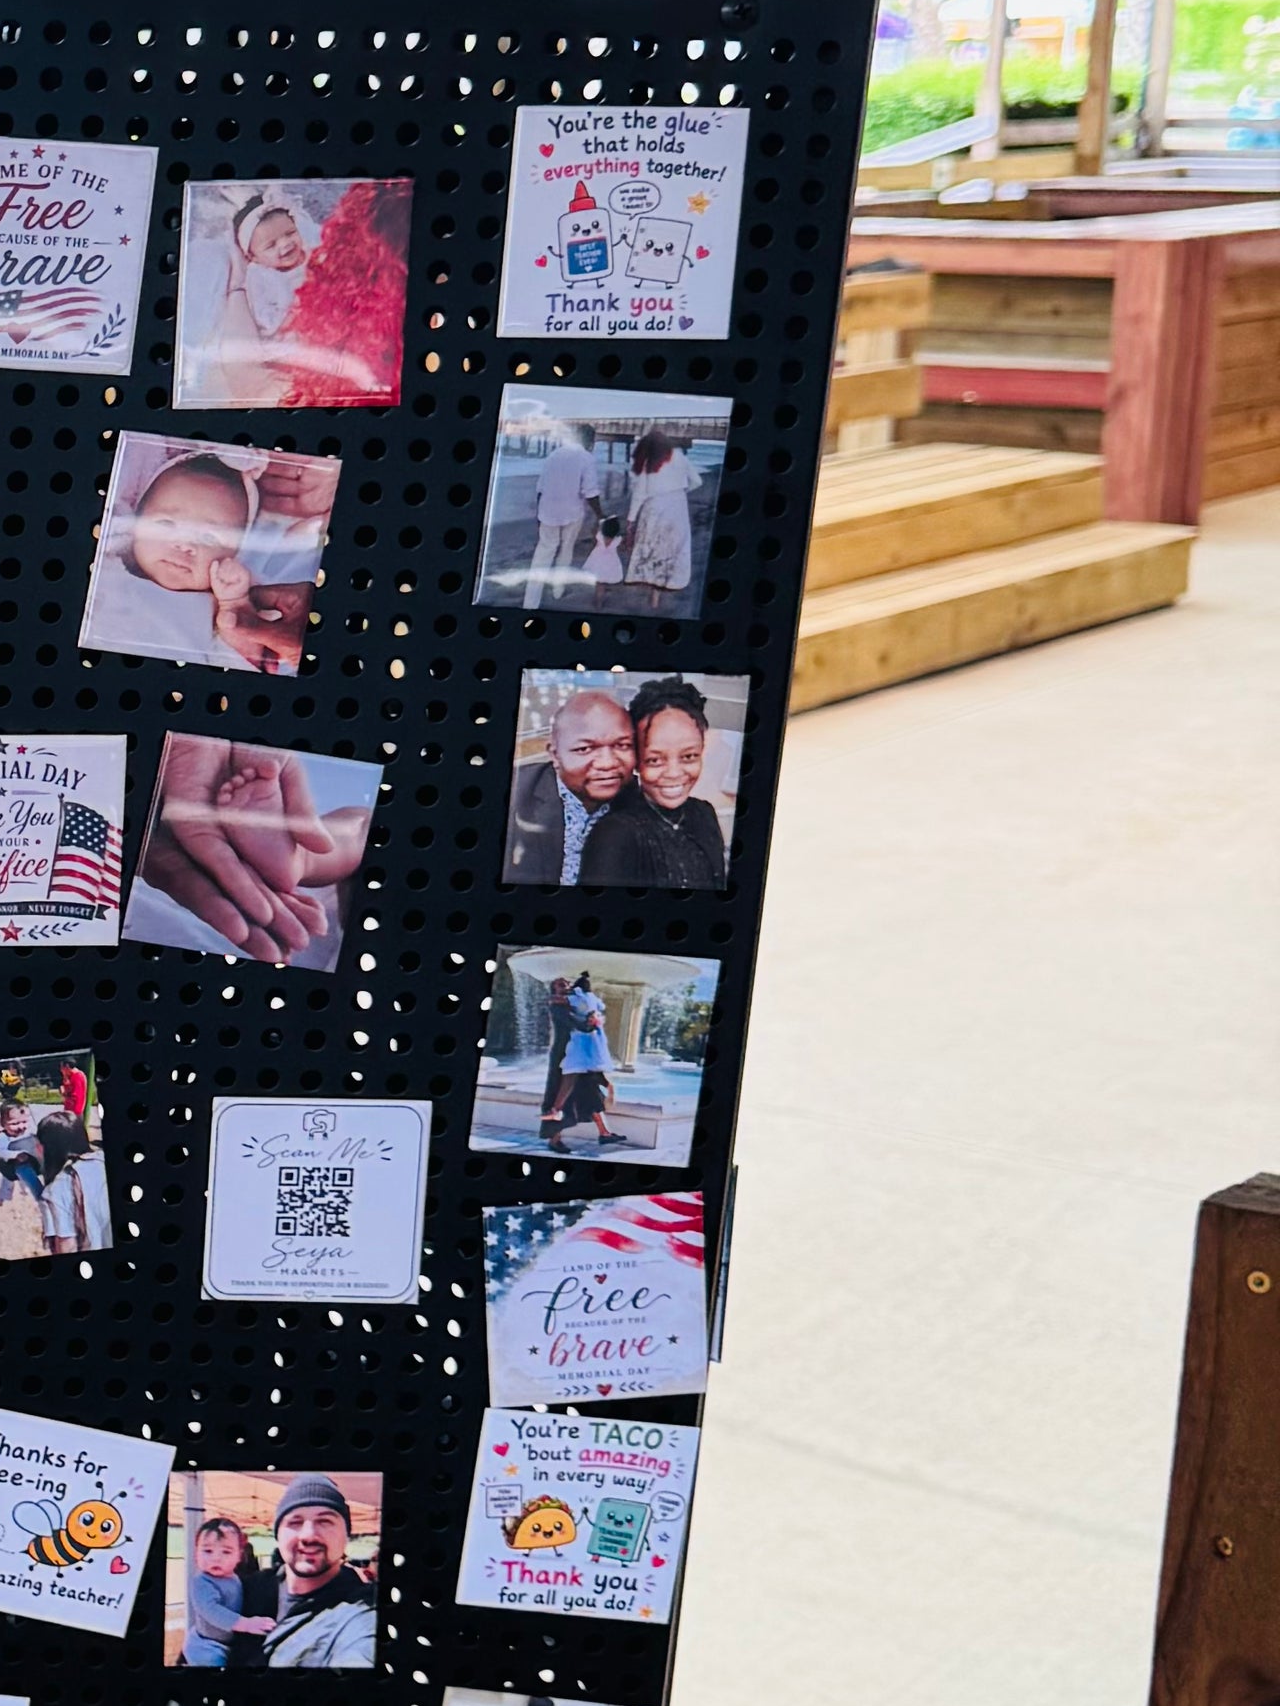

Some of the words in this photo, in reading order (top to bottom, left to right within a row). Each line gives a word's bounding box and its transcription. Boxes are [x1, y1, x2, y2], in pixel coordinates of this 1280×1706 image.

[548, 112, 614, 139] You're
[621, 112, 657, 129] the
[664, 112, 711, 136] glue
[583, 137, 628, 153] that
[636, 135, 685, 153] holds
[38, 164, 64, 179] OF
[72, 170, 109, 193] THE
[543, 158, 640, 181] everything
[646, 159, 727, 182] together!
[43, 237, 59, 246] OF
[65, 237, 90, 248] THE
[545, 294, 620, 312] Thank
[630, 297, 674, 316] you
[545, 316, 573, 332] for
[579, 315, 600, 331] all
[608, 319, 641, 335] you
[645, 316, 673, 331] do!
[1, 347, 49, 359] MEMORIAL
[52, 350, 69, 360] DAY
[42, 763, 87, 791] DAY
[7, 800, 56, 835] You
[0, 838, 30, 846] YOUR
[28, 905, 56, 913] NEVER
[59, 905, 90, 916] FORGET
[257, 1133, 324, 1168] Scan
[328, 1138, 377, 1165] Me
[563, 1264, 592, 1272] LAND
[616, 1260, 638, 1268] THE
[521, 1276, 671, 1336] free
[548, 1332, 662, 1366] brave
[558, 1369, 622, 1380] MEMORIAL
[627, 1367, 650, 1376] DAY
[511, 1418, 580, 1440] You're
[589, 1422, 663, 1450] TACO
[73, 1451, 108, 1476] for
[522, 1443, 571, 1462] 'bout
[579, 1448, 672, 1477] amazing
[533, 1467, 548, 1481] in
[556, 1472, 605, 1488] every
[613, 1474, 655, 1494] way!
[500, 1560, 584, 1587] Thank
[594, 1573, 638, 1593] you
[49, 1581, 124, 1609] teacher!
[498, 1587, 526, 1604] for
[533, 1591, 556, 1605] all
[563, 1594, 596, 1611] you
[604, 1595, 635, 1611] do!
